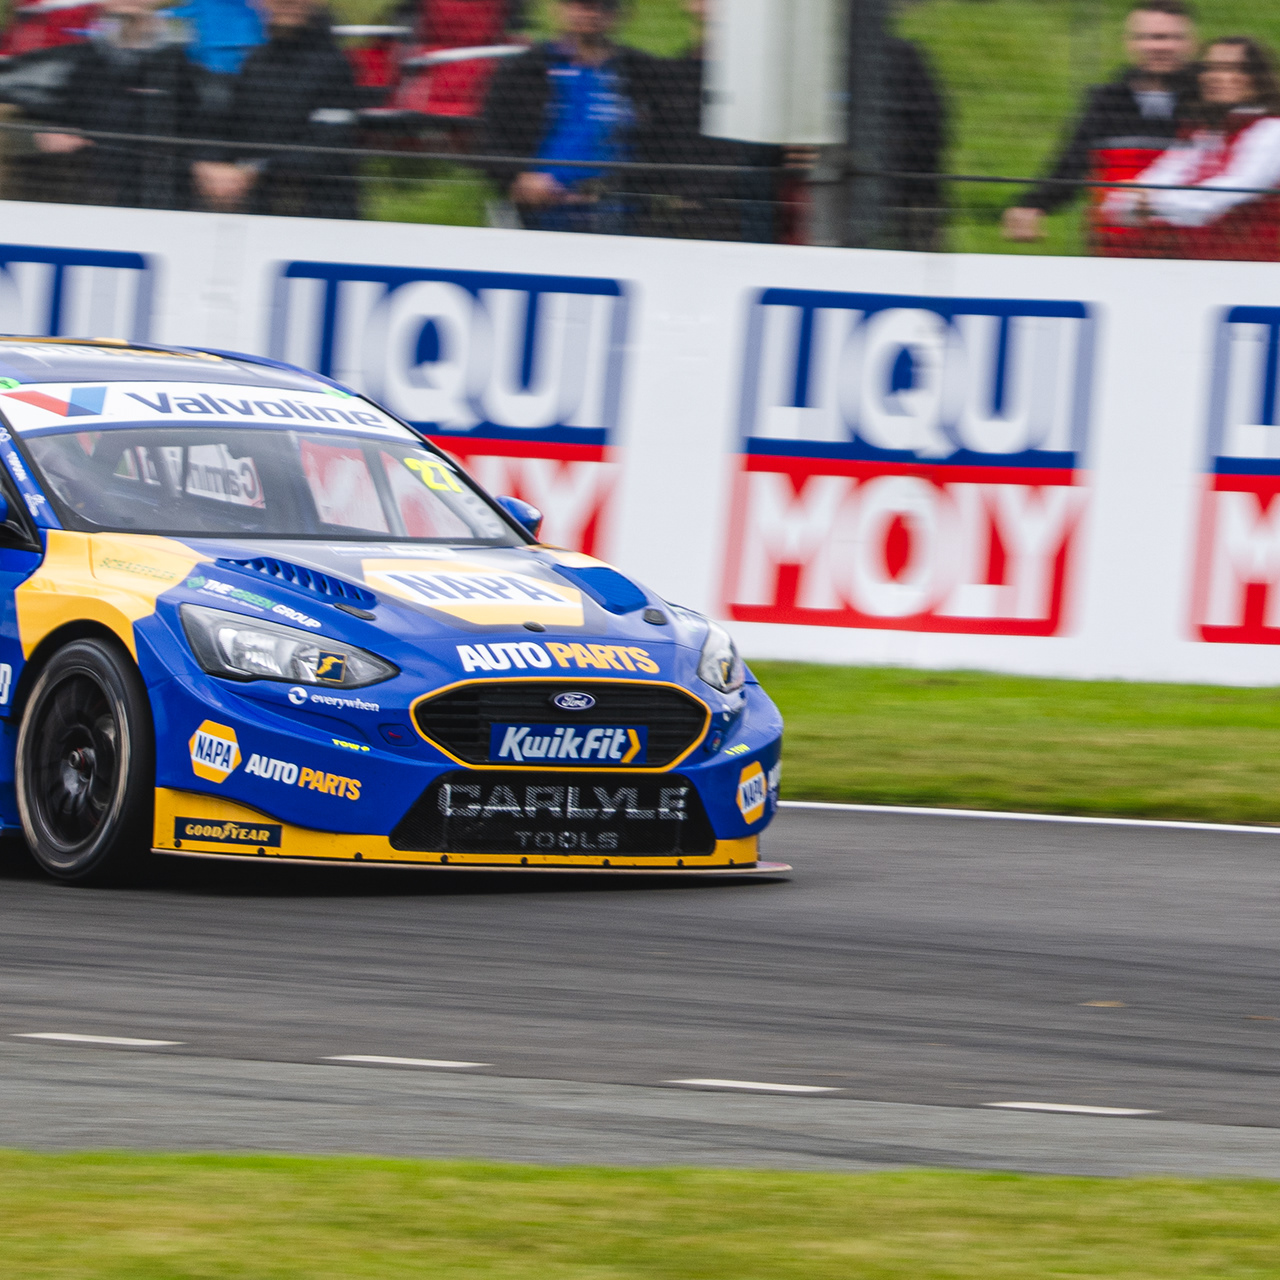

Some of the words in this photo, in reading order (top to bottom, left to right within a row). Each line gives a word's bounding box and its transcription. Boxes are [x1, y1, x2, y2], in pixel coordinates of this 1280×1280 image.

[756, 305, 1080, 459] LIQUI
[124, 391, 388, 429] Valvoline
[404, 458, 464, 493] 27
[730, 472, 1092, 620] MOLY
[387, 573, 567, 602] NAPA
[272, 604, 322, 627] GROUP
[456, 642, 552, 672] AUTO
[546, 642, 661, 673] PARTS
[310, 693, 380, 712] everywhen
[195, 734, 234, 770] NAPA
[332, 739, 360, 750] TOW
[244, 753, 299, 785] AUTO
[297, 767, 362, 801] PARTS
[741, 774, 764, 809] NAPA
[438, 783, 689, 821] CARLYLE
[185, 823, 270, 841] GOODYEAR
[516, 830, 619, 849] TOOLS
